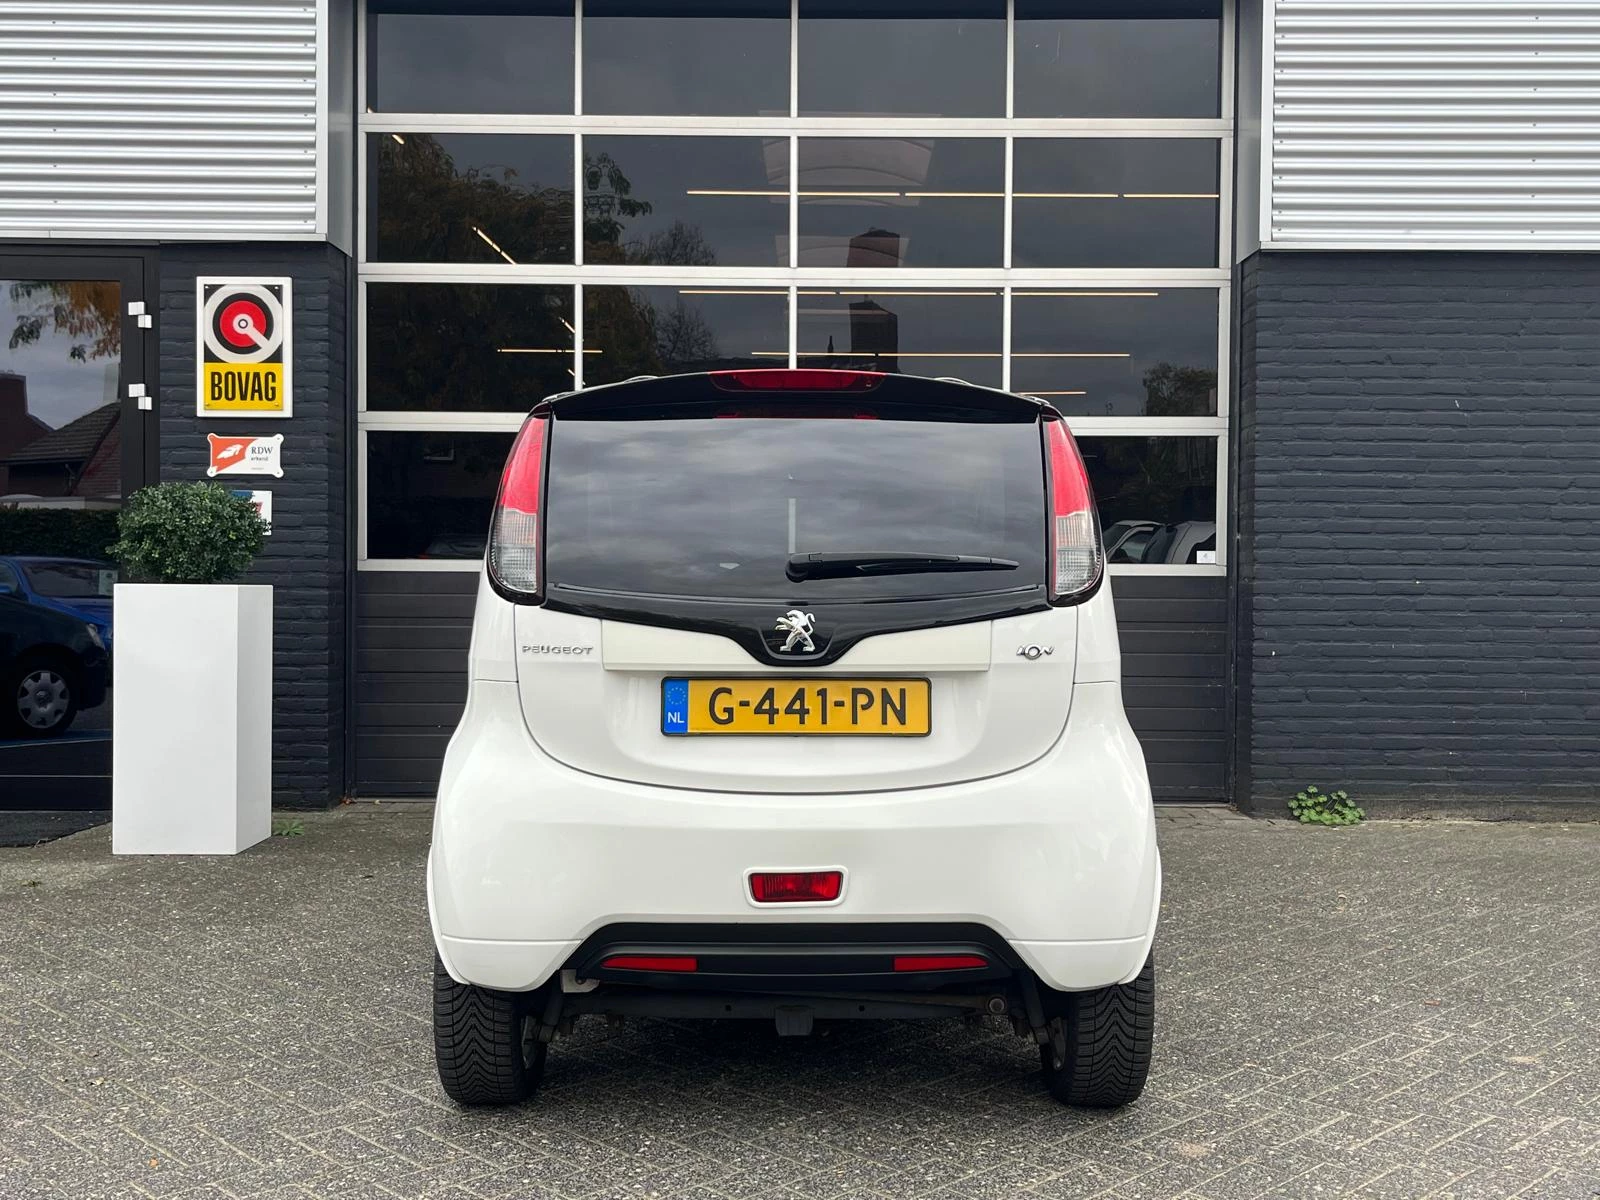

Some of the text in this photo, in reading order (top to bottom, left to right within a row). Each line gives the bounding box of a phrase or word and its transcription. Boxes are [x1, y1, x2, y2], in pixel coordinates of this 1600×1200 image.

[210, 371, 277, 402] BOVAG
[251, 446, 273, 455] RDW
[522, 645, 594, 655] PEUGEOT
[708, 686, 907, 726] G-441-PN
[667, 711, 685, 724] NL
